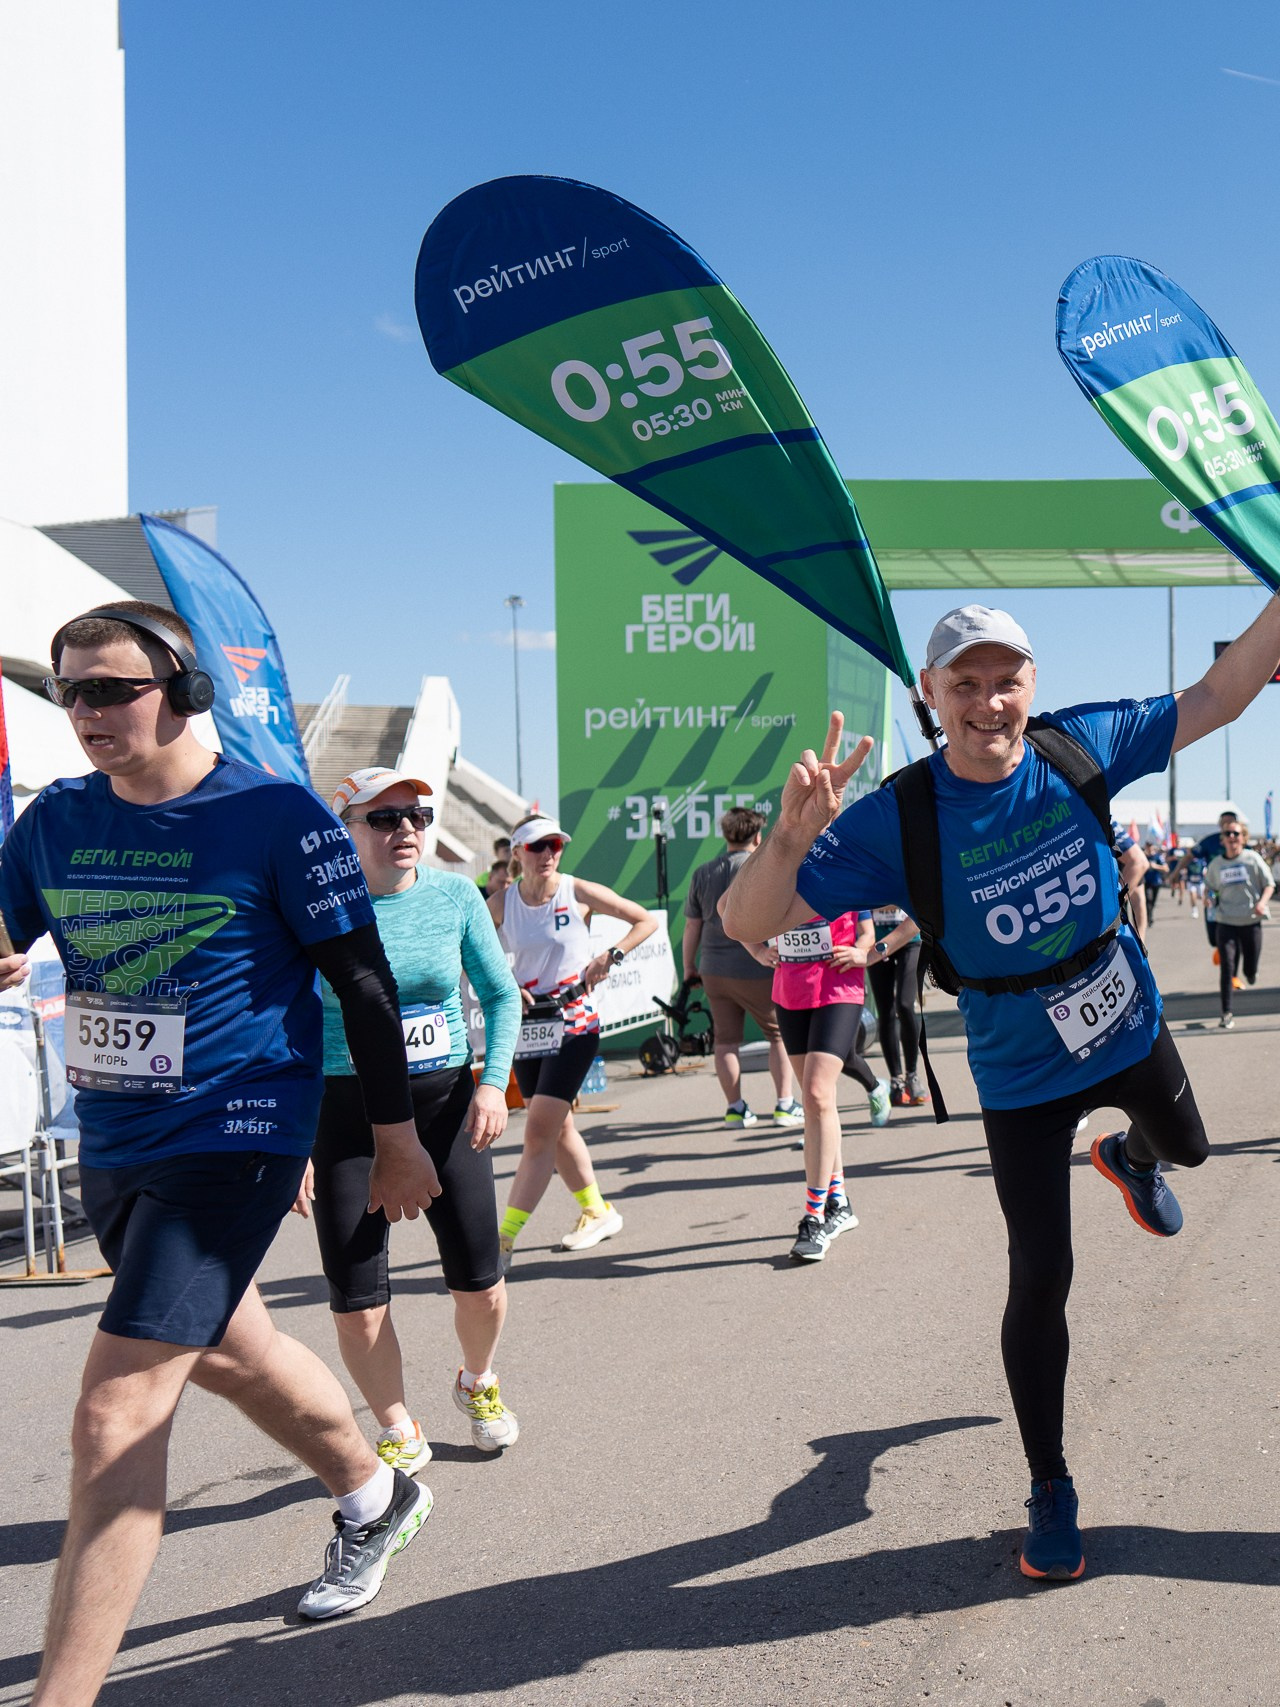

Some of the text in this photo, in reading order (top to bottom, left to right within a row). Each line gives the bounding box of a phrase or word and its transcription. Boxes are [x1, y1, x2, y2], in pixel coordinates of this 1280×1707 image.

[551, 316, 733, 423] 0:55
[632, 398, 712, 442] 05:30
[1147, 380, 1256, 462] 0:55
[1203, 449, 1246, 480] 05:30
[641, 593, 739, 624] БЕГИ,
[323, 827, 350, 844] ПСБ
[959, 800, 1072, 868] БЕГИ, ГЕРОЙ!
[70, 849, 193, 868] БЕГИ, ГЕРОЙ!
[970, 837, 1085, 904] ПЕЙСМЕЙКЕР
[61, 889, 187, 921] ГЕРОИ
[985, 858, 1096, 945] 0:55
[61, 919, 184, 943] МЕНЯЮТ
[784, 931, 821, 947] 5583
[68, 941, 184, 977] ЭТОТ
[1079, 971, 1126, 1027] 0:55
[1081, 969, 1113, 1000] ПЕЙСМЕЙКЕР
[79, 1014, 156, 1051] 5359
[522, 1025, 555, 1042] 5584
[93, 1053, 128, 1067] ИГОРЬ
[247, 1099, 277, 1108] ПСБ
